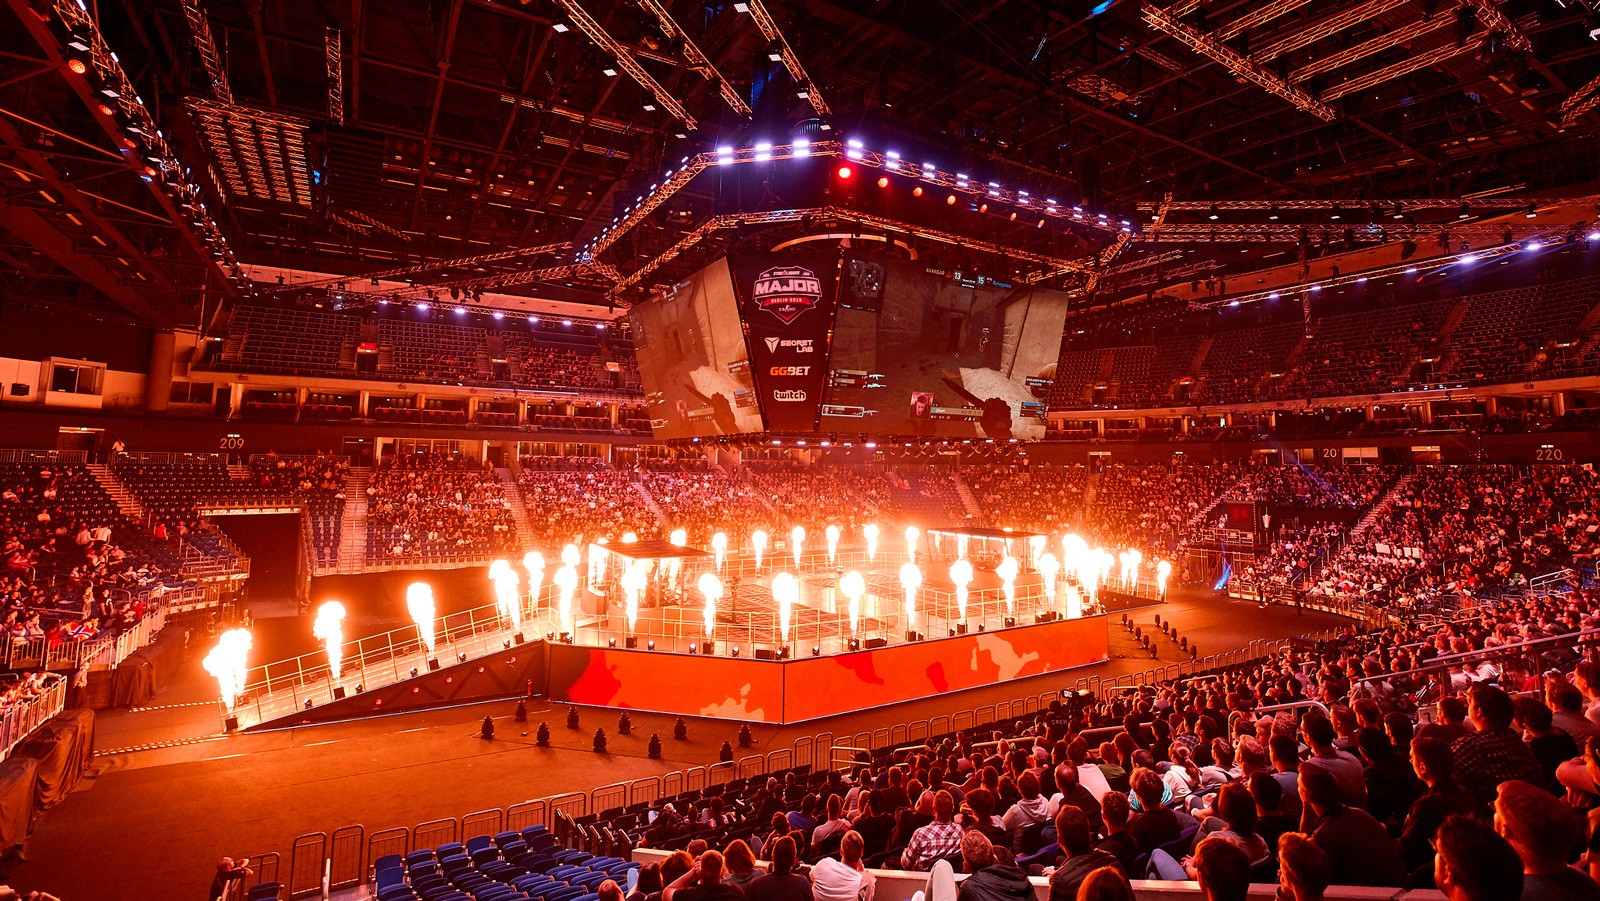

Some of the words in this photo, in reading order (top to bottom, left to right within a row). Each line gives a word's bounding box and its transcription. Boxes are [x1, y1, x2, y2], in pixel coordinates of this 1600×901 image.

[954, 271, 962, 280] 13
[977, 276, 985, 285] 15
[754, 279, 821, 296] MAJOR
[780, 339, 814, 347] SECRET
[774, 390, 807, 402] twitch
[220, 437, 245, 449] 209
[872, 453, 886, 461] 204
[1536, 449, 1563, 461] 220
